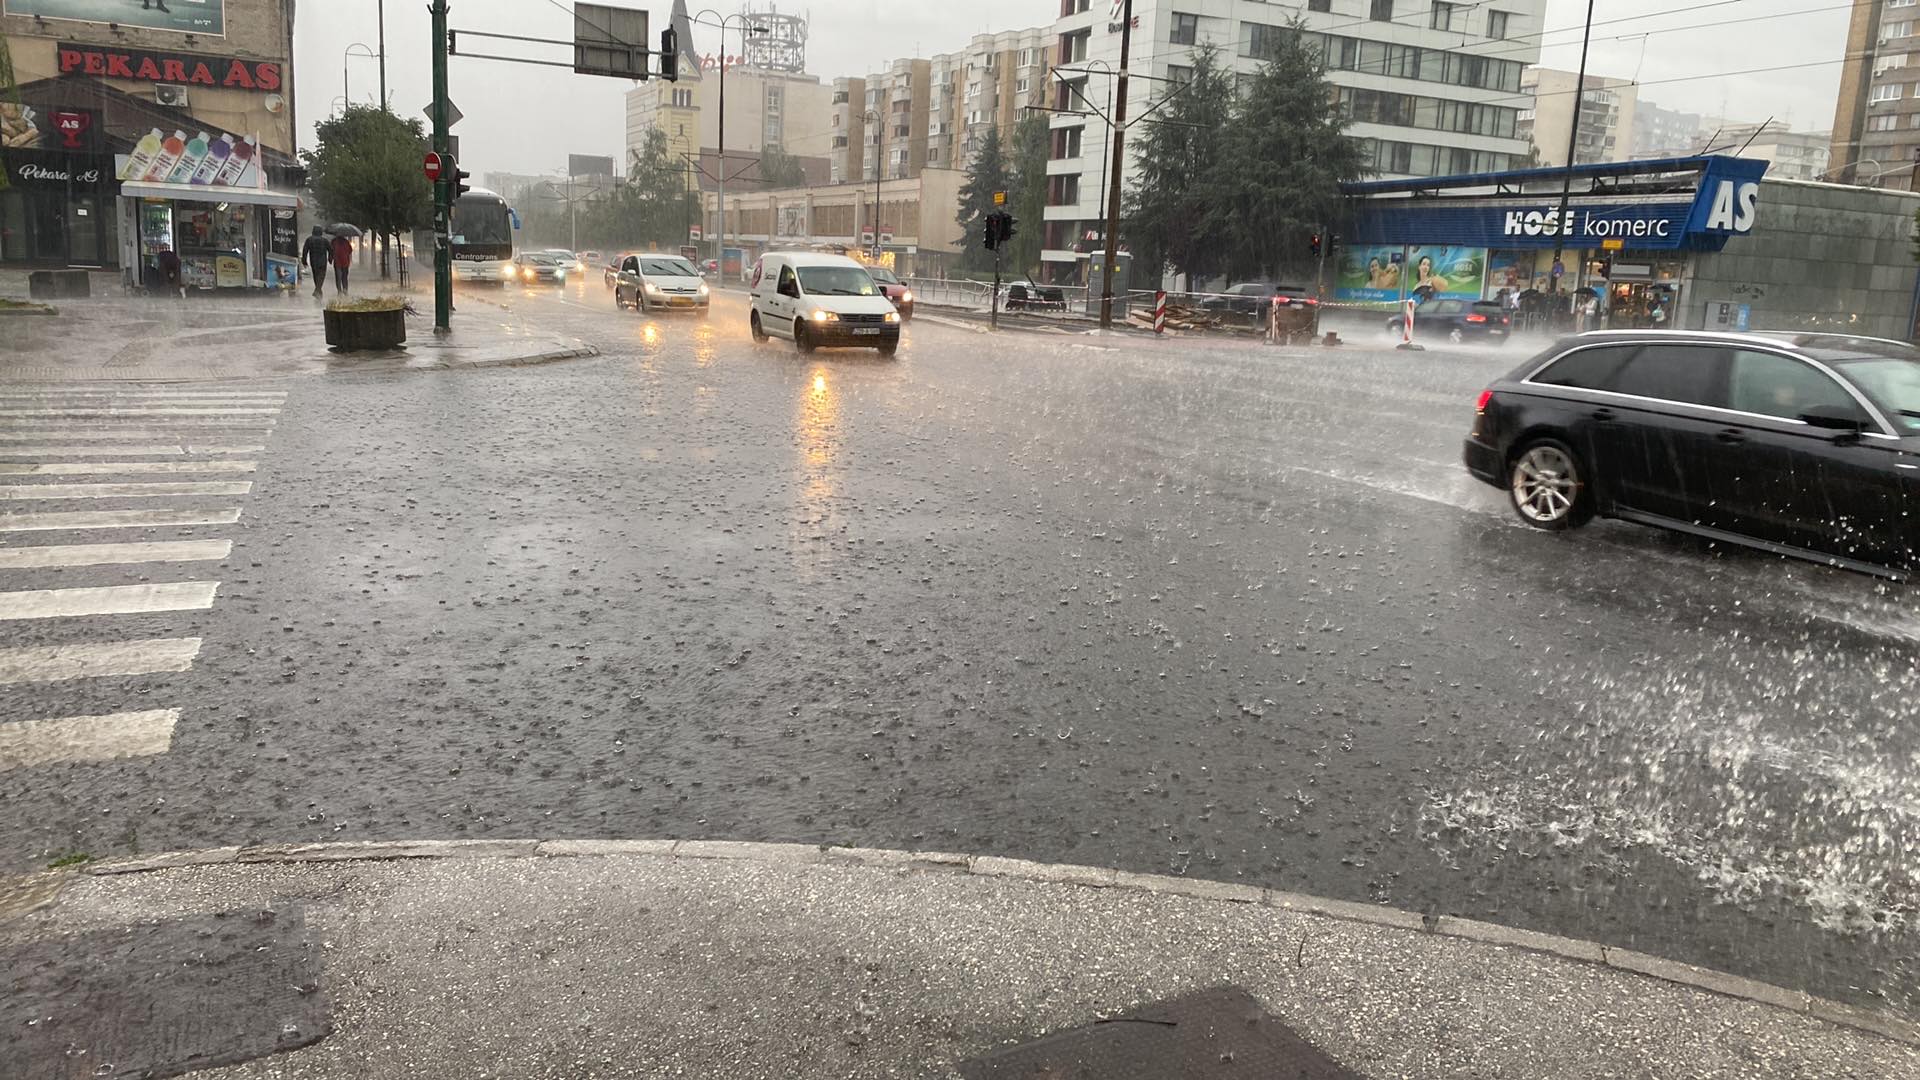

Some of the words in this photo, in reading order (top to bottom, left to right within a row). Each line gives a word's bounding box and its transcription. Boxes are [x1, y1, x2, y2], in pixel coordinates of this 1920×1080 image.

[60, 50, 215, 85] PEKARA
[223, 60, 280, 90] AS
[61, 119, 79, 129] AS
[18, 164, 70, 180] Pekara
[1706, 181, 1759, 232] AS
[1504, 206, 1575, 236] HOŠE
[1583, 211, 1670, 237] komerc
[455, 252, 498, 261] Centrotrans
